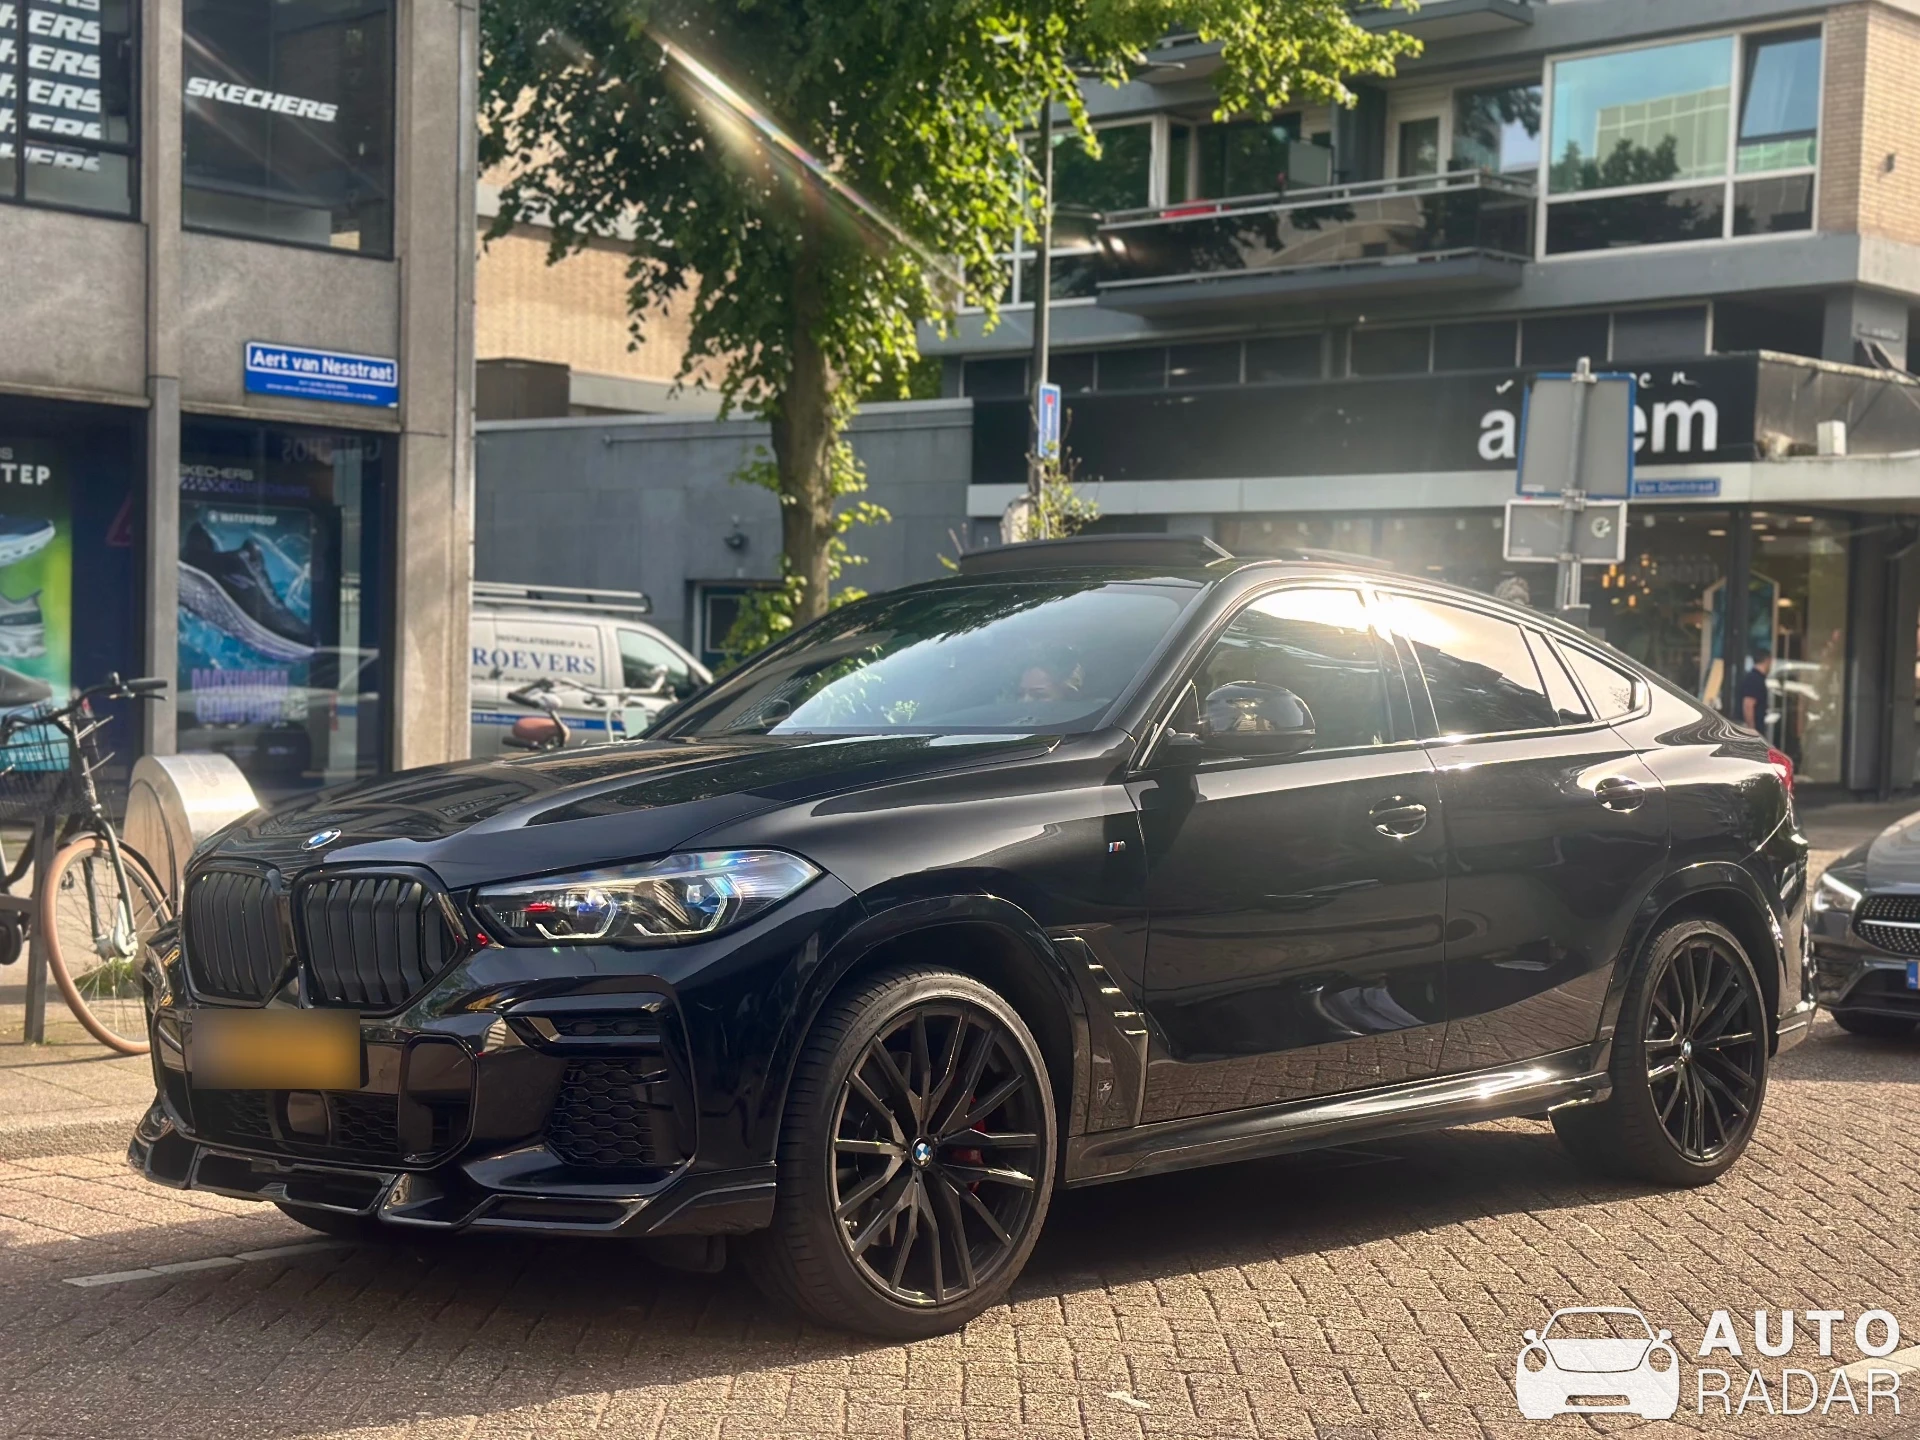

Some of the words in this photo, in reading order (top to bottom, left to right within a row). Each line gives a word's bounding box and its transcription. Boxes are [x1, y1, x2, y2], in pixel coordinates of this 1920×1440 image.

[185, 76, 338, 122] SKECHERS
[252, 349, 288, 369] Aert
[292, 356, 319, 373] van
[322, 357, 392, 381] Nesstraat
[0, 463, 51, 486] TEP
[472, 647, 596, 675] ROEVERS
